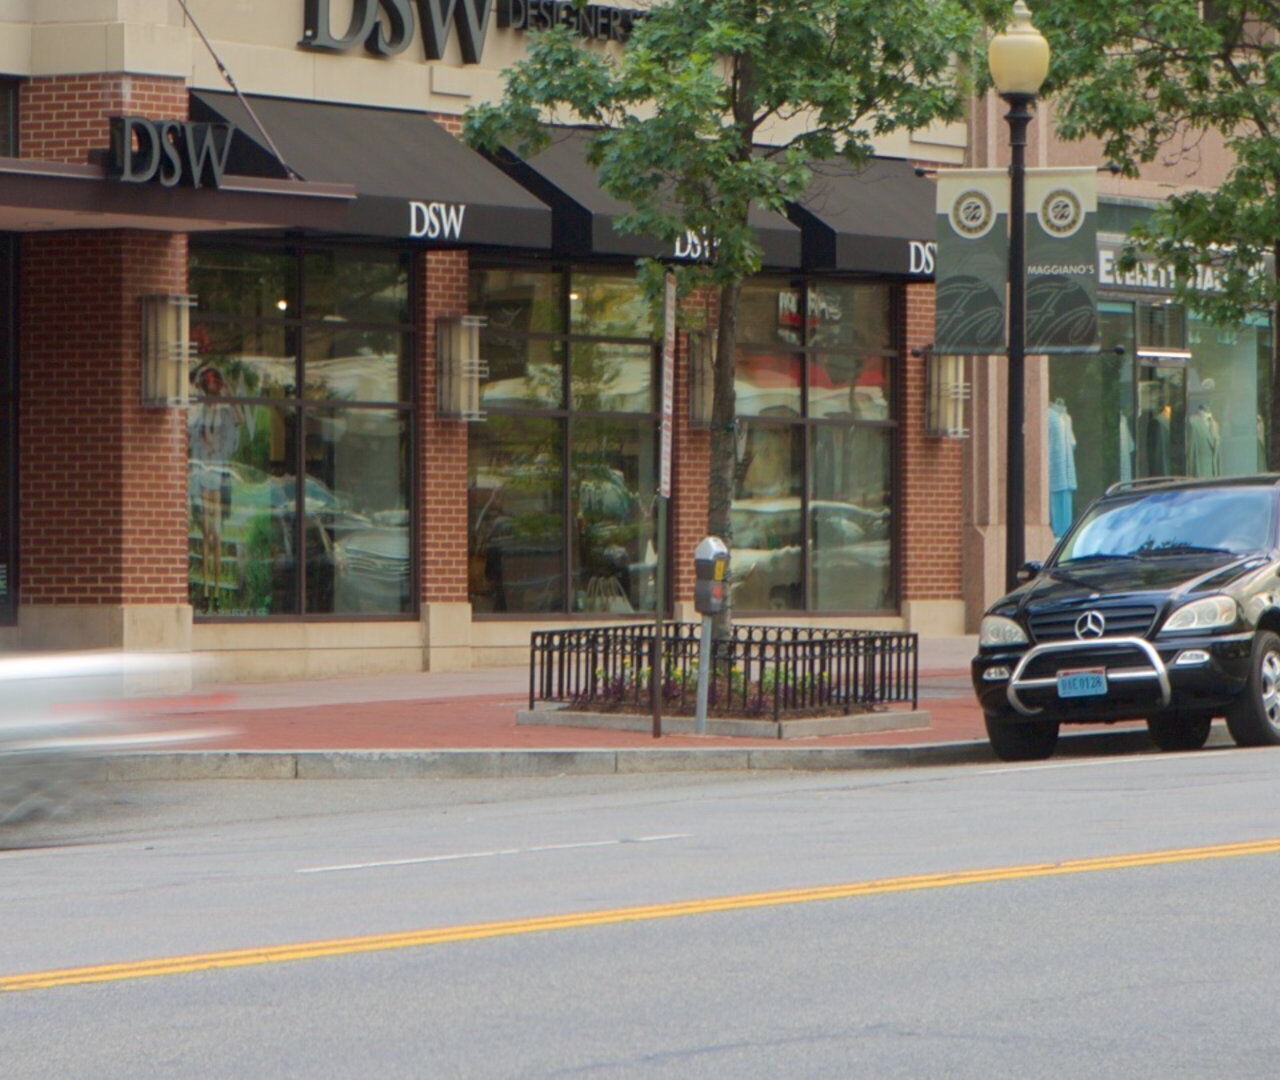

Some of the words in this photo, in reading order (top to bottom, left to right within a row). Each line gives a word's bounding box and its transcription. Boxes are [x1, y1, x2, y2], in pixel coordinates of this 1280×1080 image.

[112, 117, 236, 188] DSW
[408, 201, 465, 241] DSW
[673, 226, 723, 259] DS
[908, 241, 938, 275] DS
[1027, 265, 1095, 276] MAGGIANO'S
